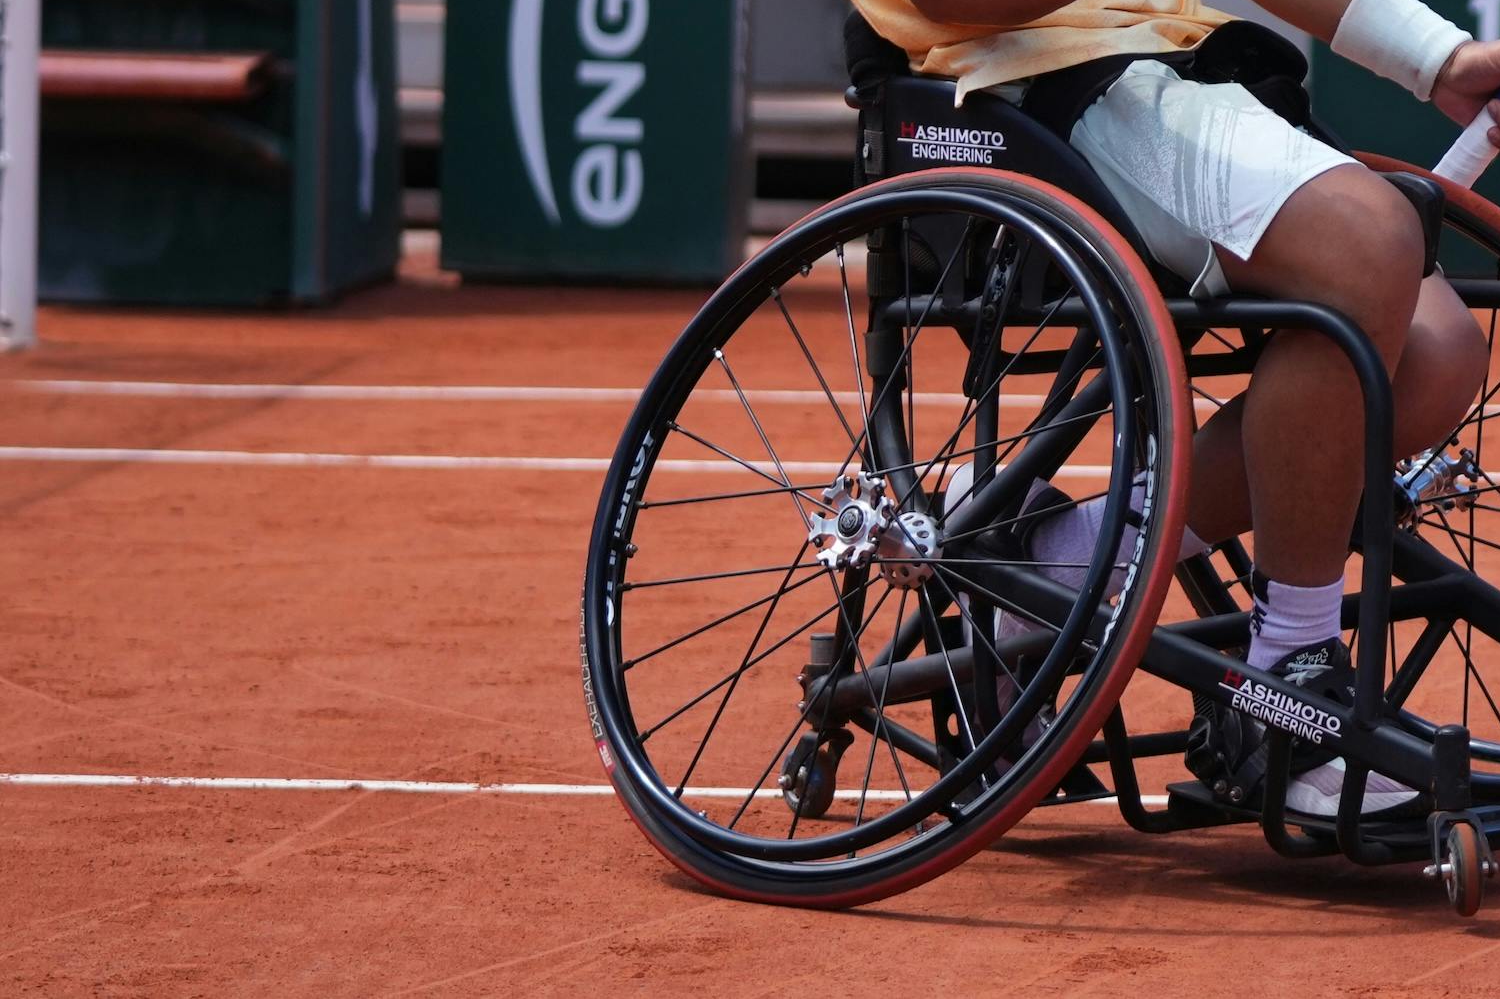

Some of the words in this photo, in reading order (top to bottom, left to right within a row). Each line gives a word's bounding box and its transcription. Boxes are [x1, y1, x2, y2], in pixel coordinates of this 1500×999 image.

[901, 121, 1005, 146] HASHIMOTO
[912, 142, 993, 164] ENGINEERING
[1224, 668, 1342, 733] HASHIMOTO
[1231, 693, 1324, 745] ENGINEERING
